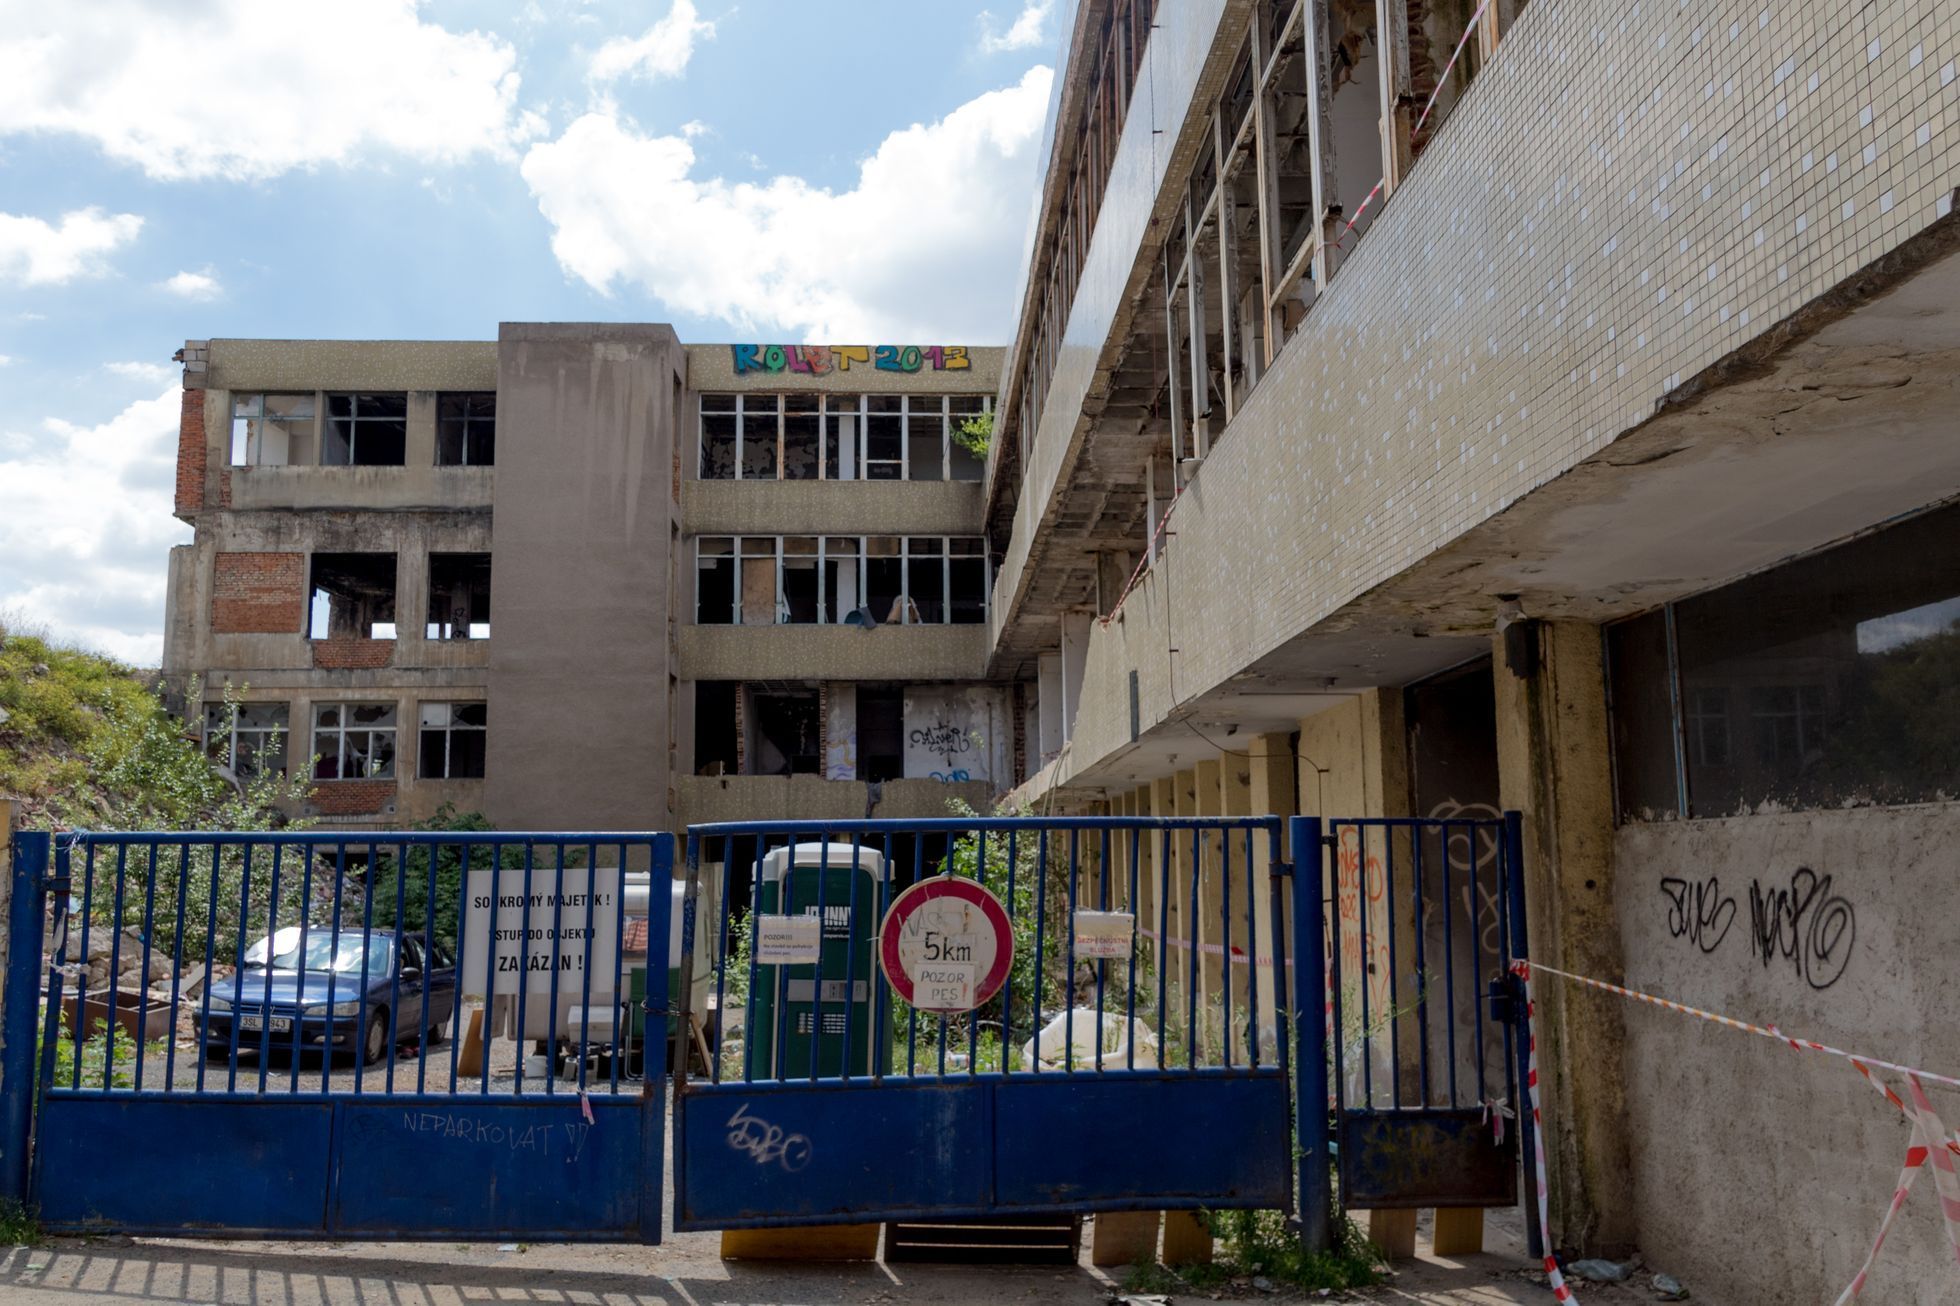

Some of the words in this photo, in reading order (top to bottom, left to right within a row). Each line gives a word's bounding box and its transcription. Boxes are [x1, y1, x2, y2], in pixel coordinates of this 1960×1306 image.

[874, 344, 972, 373] 2013
[474, 892, 543, 908] SOKROMÝ
[489, 929, 524, 940] STUP
[499, 952, 571, 971] ZAÁZN
[920, 971, 965, 984] POZOR
[931, 988, 958, 1001] PES
